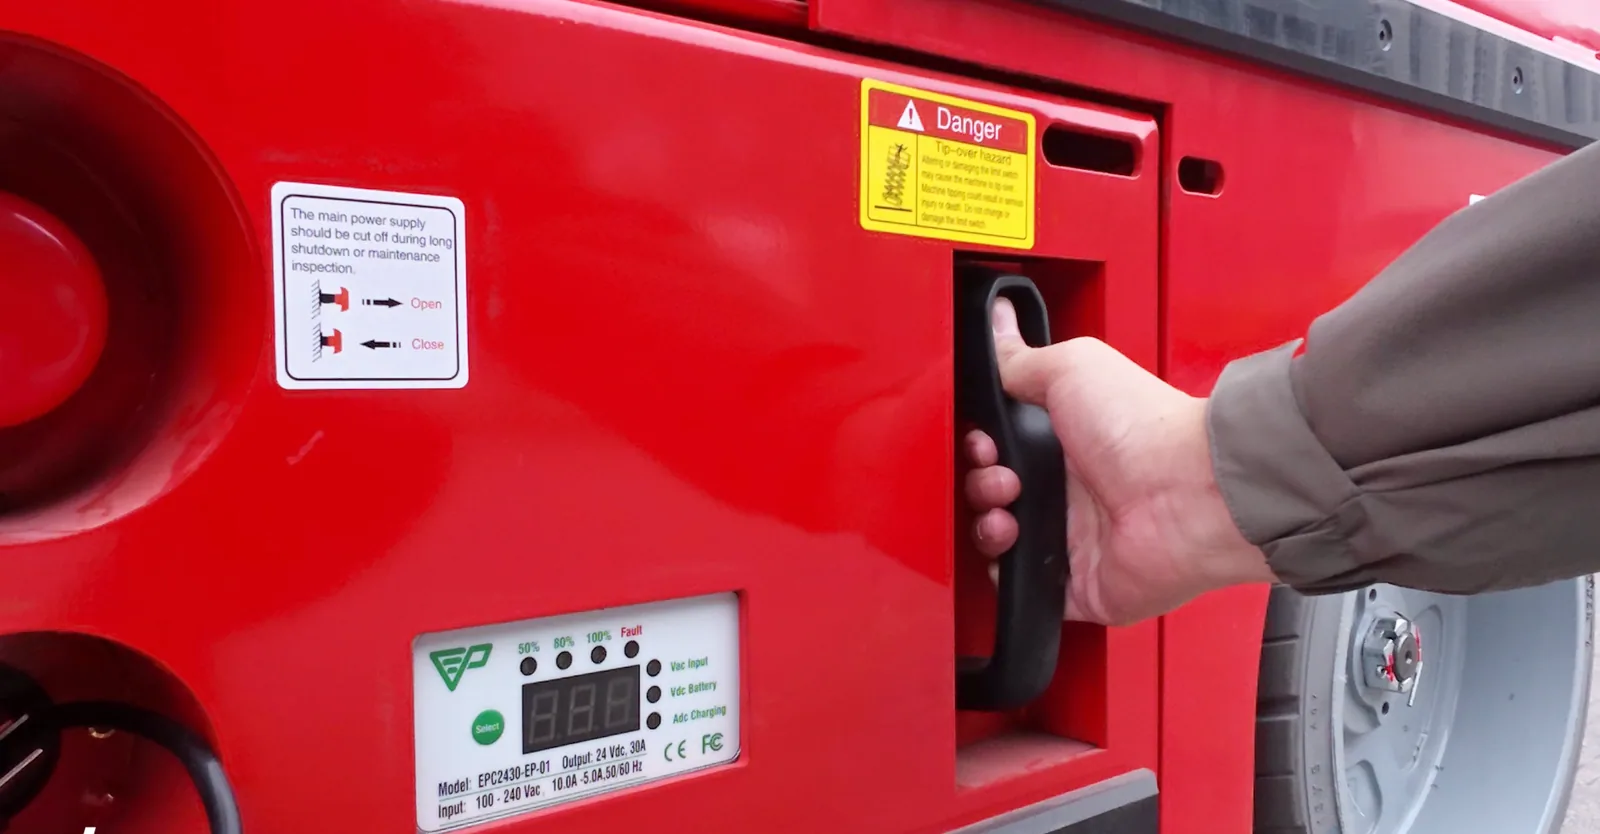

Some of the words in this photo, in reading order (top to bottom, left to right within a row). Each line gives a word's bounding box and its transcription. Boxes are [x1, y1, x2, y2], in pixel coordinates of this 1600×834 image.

[937, 107, 1002, 142] Danger
[936, 141, 978, 159] Tip-over
[980, 149, 1011, 165] hazard
[291, 207, 314, 220] The
[318, 211, 347, 222] main
[351, 214, 387, 226] power
[390, 218, 426, 231] supply
[291, 227, 331, 239] should
[335, 228, 350, 239] be
[353, 231, 371, 241] cut
[374, 232, 388, 242] off
[392, 233, 426, 247] during
[429, 235, 452, 249] long
[291, 243, 350, 256] shutdown
[353, 248, 365, 257] or
[368, 248, 440, 262] maintenance
[292, 260, 356, 275] inspection.
[411, 297, 442, 310] Open
[412, 339, 444, 350] Close
[518, 641, 540, 654] 50%
[554, 636, 574, 649] 80%
[586, 630, 612, 643] 100%
[621, 625, 642, 637] Fault
[671, 660, 685, 672] Vac
[688, 657, 708, 669] Input
[671, 686, 686, 697] Vdc
[688, 681, 717, 693] Battery
[673, 712, 688, 724] Adc
[691, 705, 726, 720] Charging
[476, 722, 499, 734] Select
[438, 778, 471, 797] Model:
[478, 760, 550, 788] EPC2430-EP-01
[562, 752, 593, 769] Output:
[596, 748, 607, 762] 24
[630, 739, 646, 754] 30A
[438, 802, 466, 820] Input:
[476, 794, 494, 810] 100
[504, 790, 521, 804] 240
[552, 777, 578, 791] 10.0A
[632, 760, 643, 773] Hz
